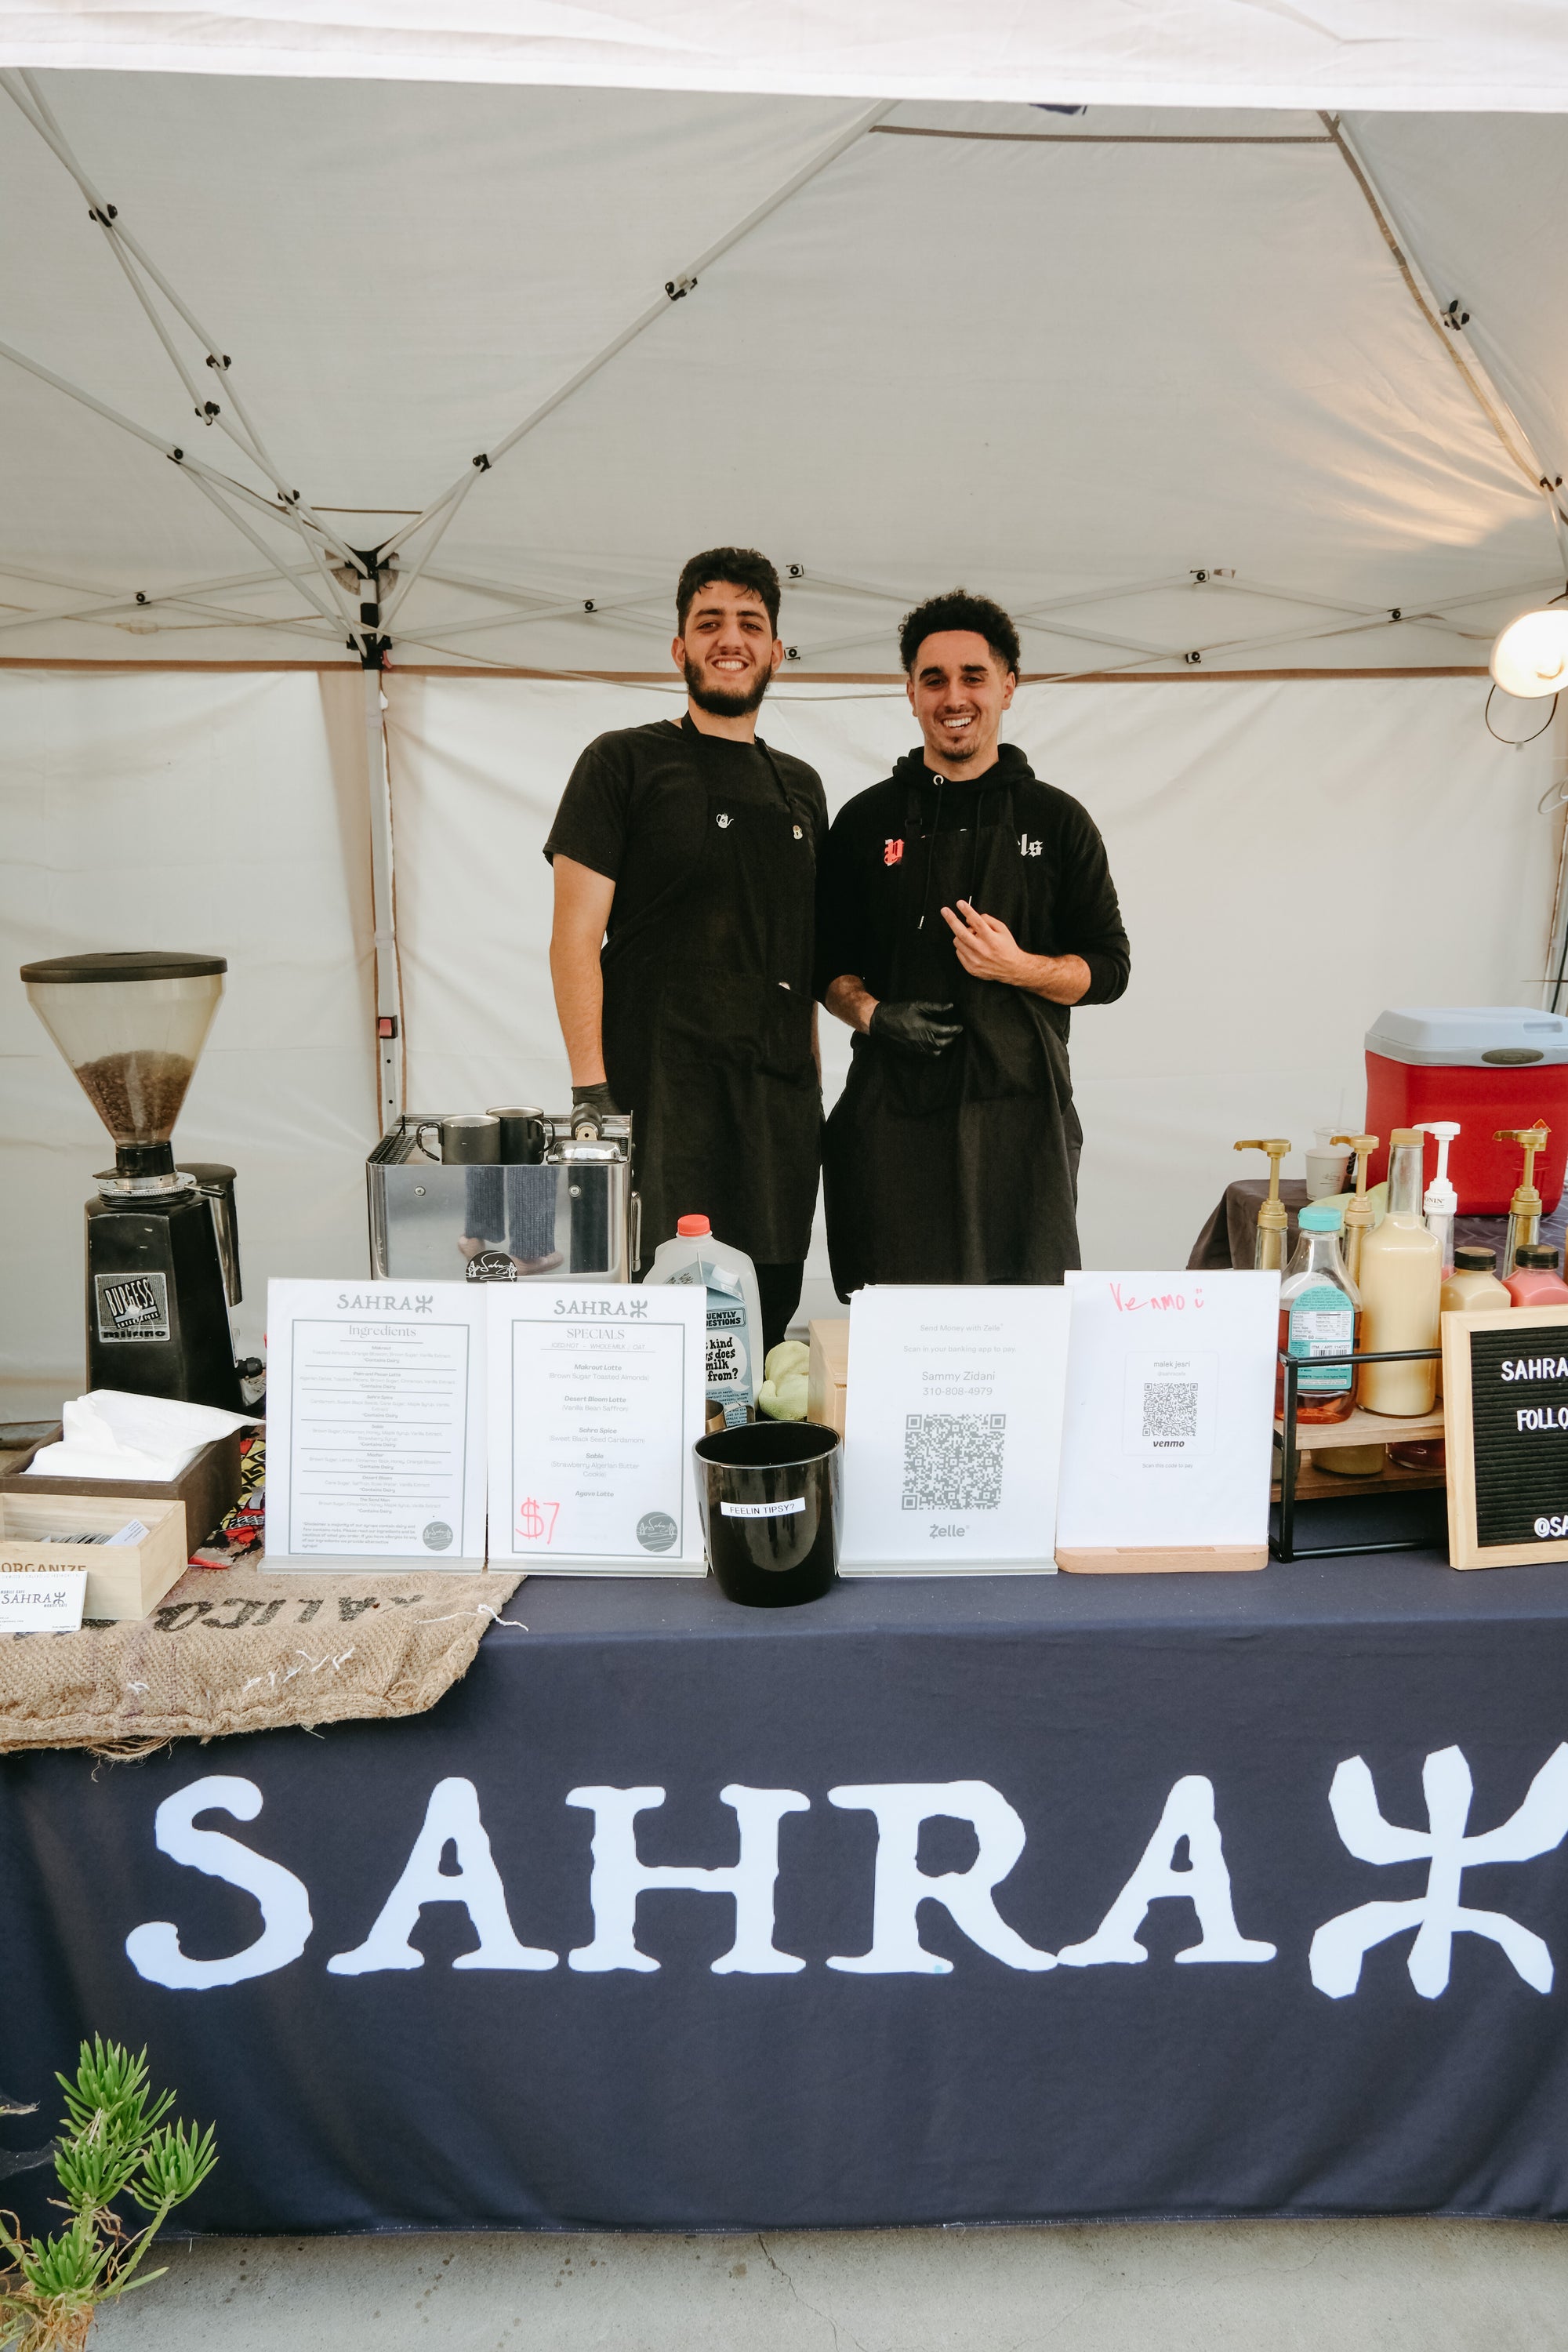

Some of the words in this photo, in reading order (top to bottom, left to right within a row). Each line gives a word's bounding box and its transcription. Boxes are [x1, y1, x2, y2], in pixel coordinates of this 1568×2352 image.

[105, 1279, 154, 1316] BURGESS
[336, 1294, 413, 1311] SAHRA
[1109, 1283, 1185, 1312] Venmo
[554, 1299, 628, 1316] SAHRA
[349, 1324, 416, 1338] Ingredients
[567, 1328, 625, 1340] SPECIALS
[710, 1337, 733, 1349] kind
[949, 1345, 976, 1354] banking
[715, 1348, 735, 1359] does
[706, 1359, 729, 1371] milk
[1501, 1356, 1568, 1381] SAHRA
[708, 1367, 739, 1381] from?
[922, 1371, 960, 1382] Sammy
[963, 1371, 996, 1381] Zidani
[923, 1387, 993, 1396] 310-808-4979
[762, 1504, 795, 1514] TIPSY?
[515, 1497, 560, 1545] $7
[2, 1593, 52, 1604] SAHRA
[125, 1774, 1276, 1990] SAHRA
